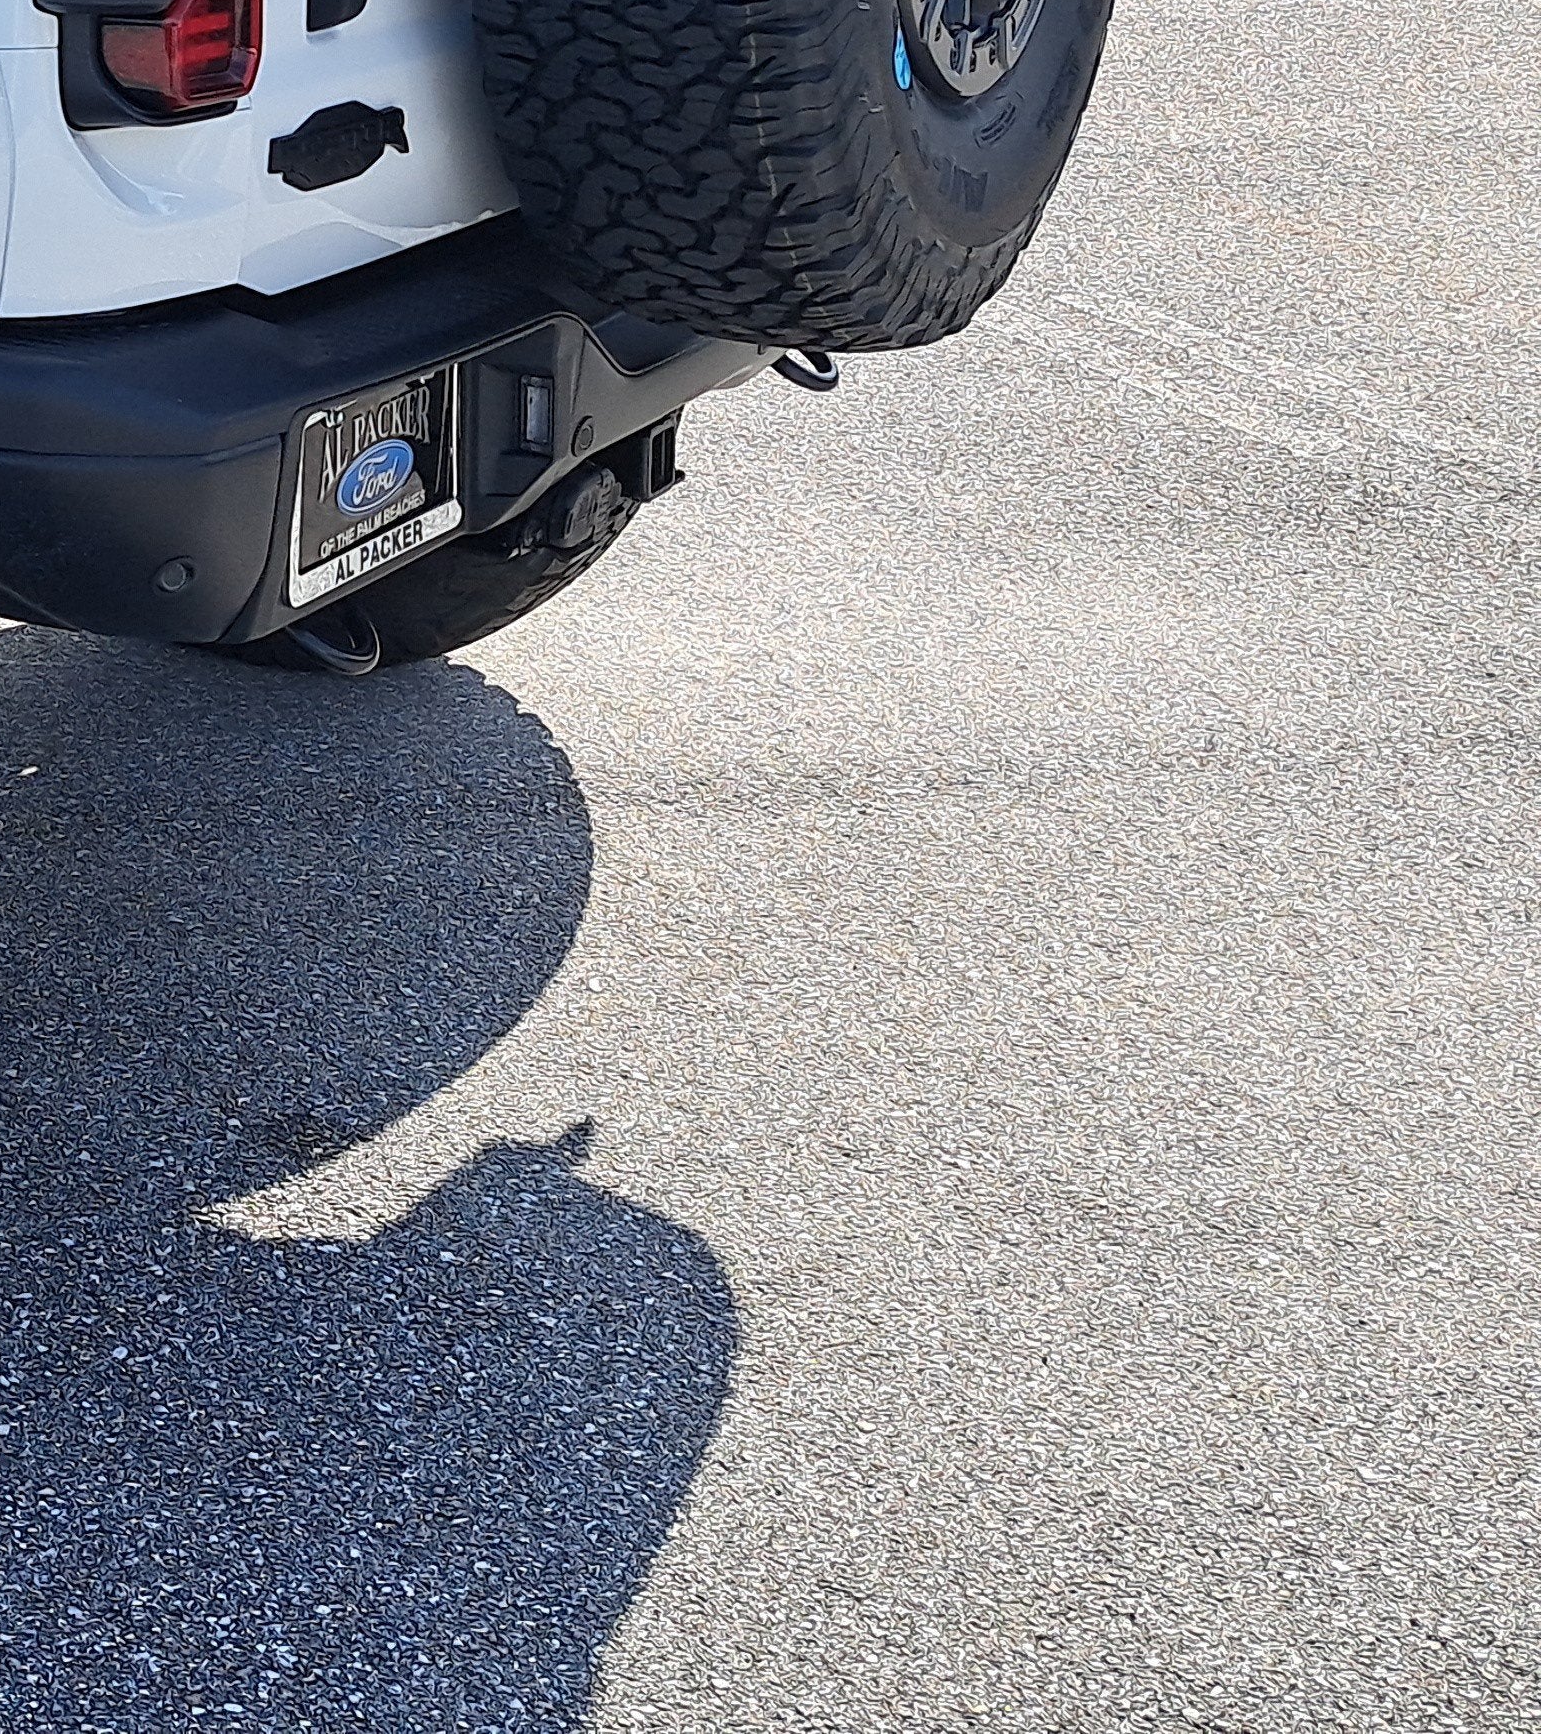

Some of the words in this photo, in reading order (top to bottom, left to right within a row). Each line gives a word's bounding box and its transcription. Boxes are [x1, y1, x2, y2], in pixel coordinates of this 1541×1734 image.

[319, 426, 349, 504] AL
[352, 385, 431, 457] PACKER
[353, 453, 397, 506] Ford
[319, 536, 336, 558] OF
[335, 525, 357, 550] THE
[356, 512, 383, 539] PALM
[383, 488, 426, 524] BEACHES
[335, 554, 355, 585] AL
[359, 519, 424, 572] PACKER
